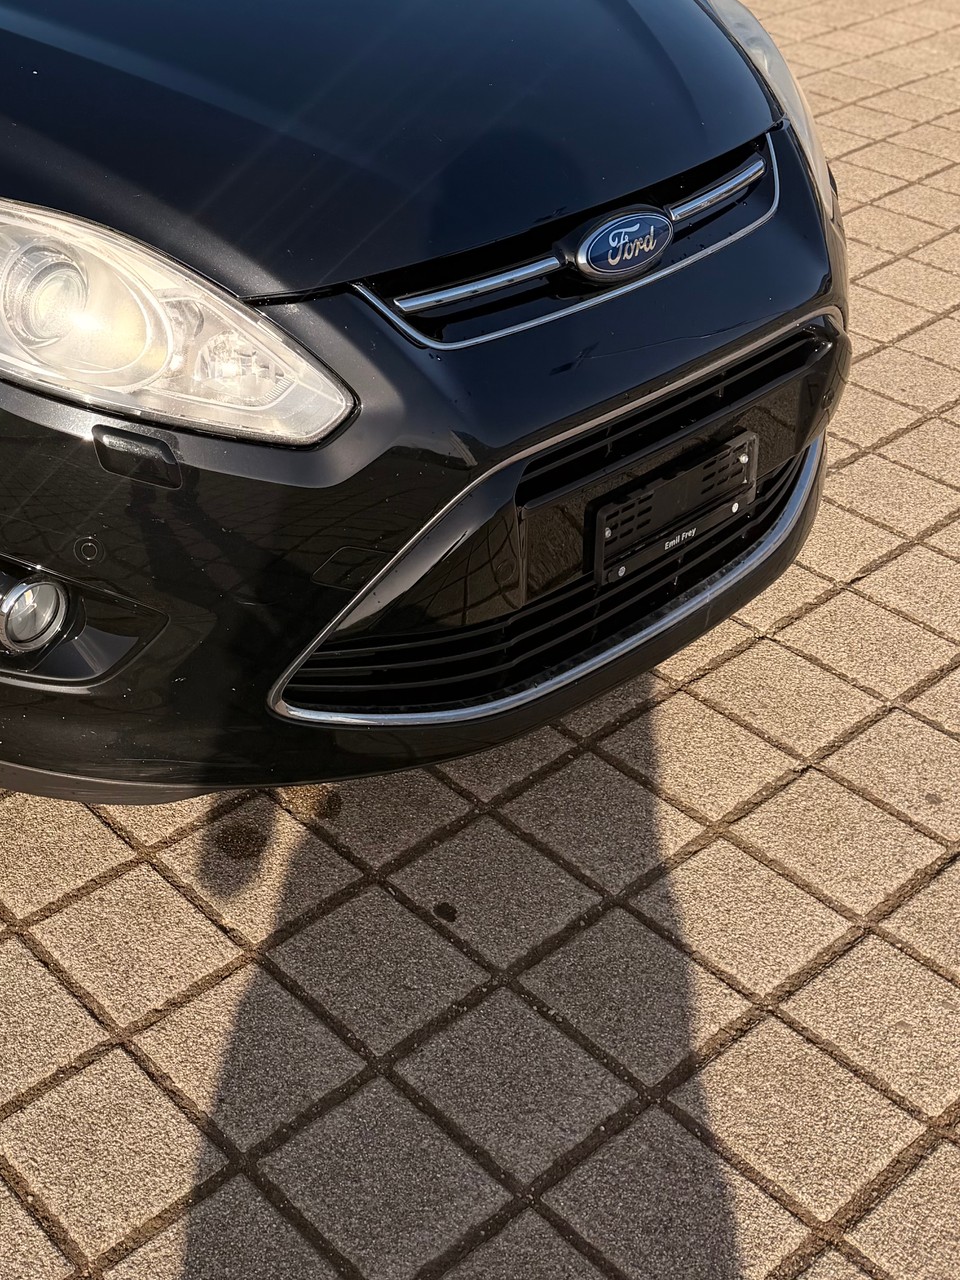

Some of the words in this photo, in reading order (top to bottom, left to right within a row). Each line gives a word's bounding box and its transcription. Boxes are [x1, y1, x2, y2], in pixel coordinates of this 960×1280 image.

[607, 223, 657, 266] Ford
[664, 534, 681, 550] Emil
[681, 527, 697, 541] Frey
